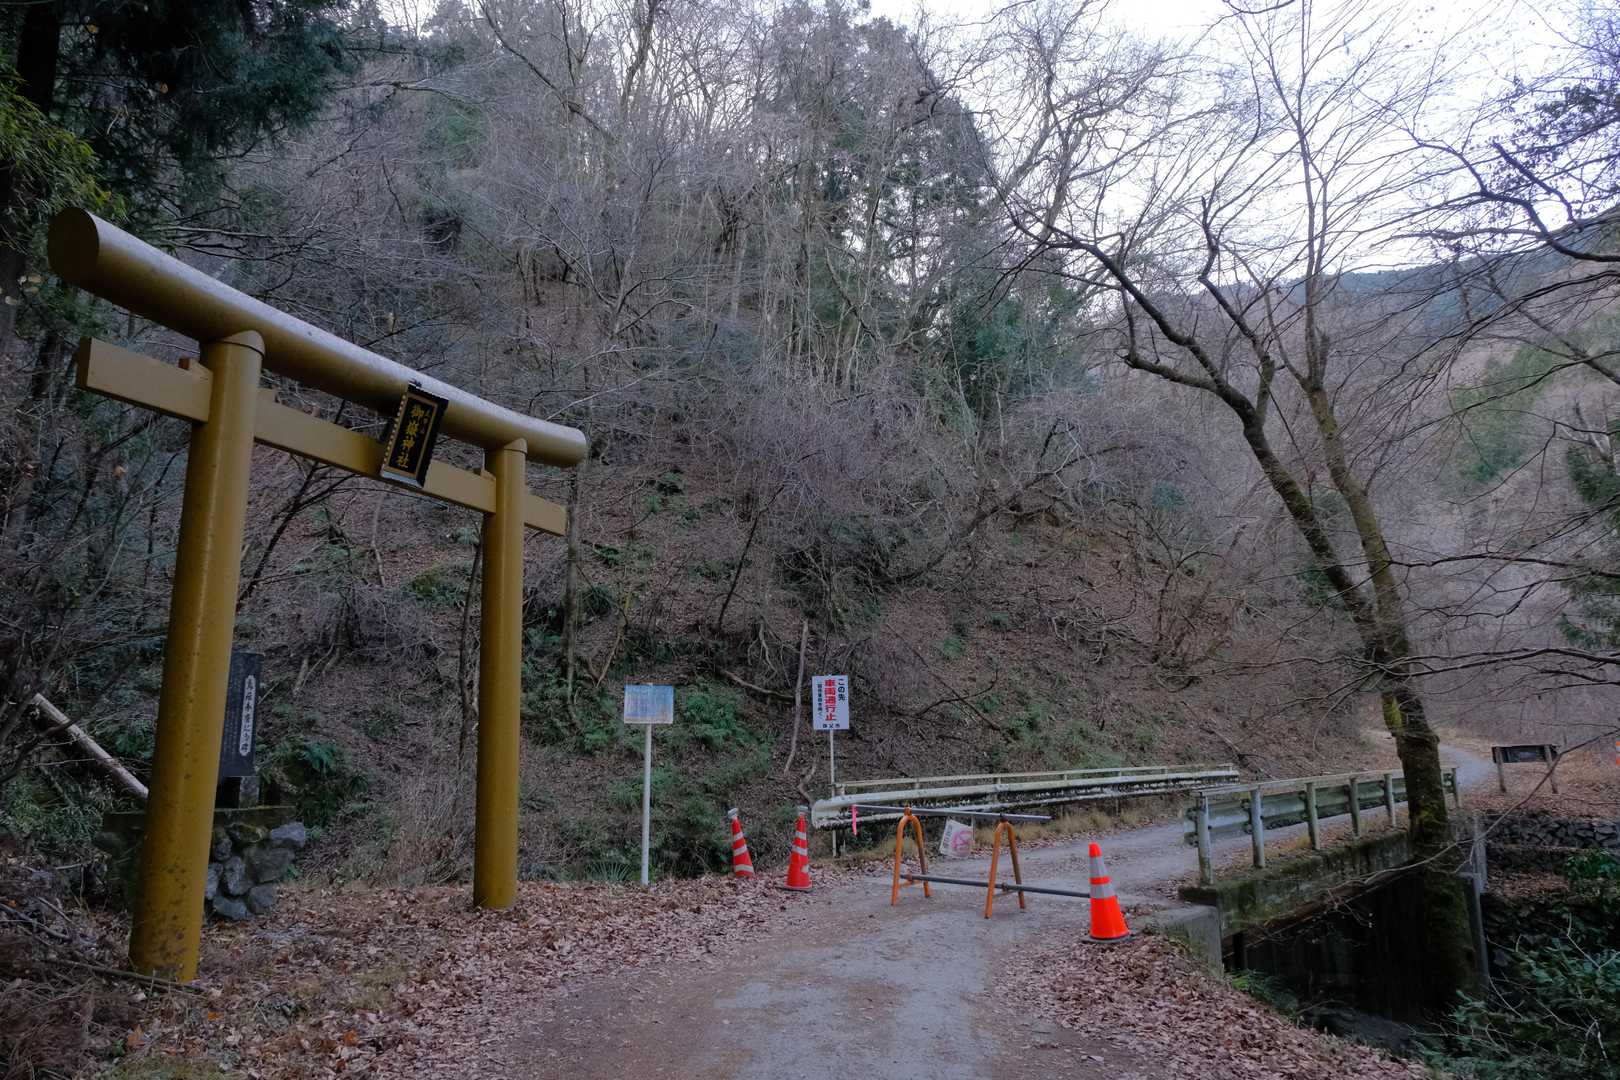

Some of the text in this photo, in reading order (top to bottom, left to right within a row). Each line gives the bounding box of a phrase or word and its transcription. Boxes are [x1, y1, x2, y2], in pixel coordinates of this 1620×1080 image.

[824, 678, 836, 722] 車両通行止
[838, 678, 846, 702] この先
